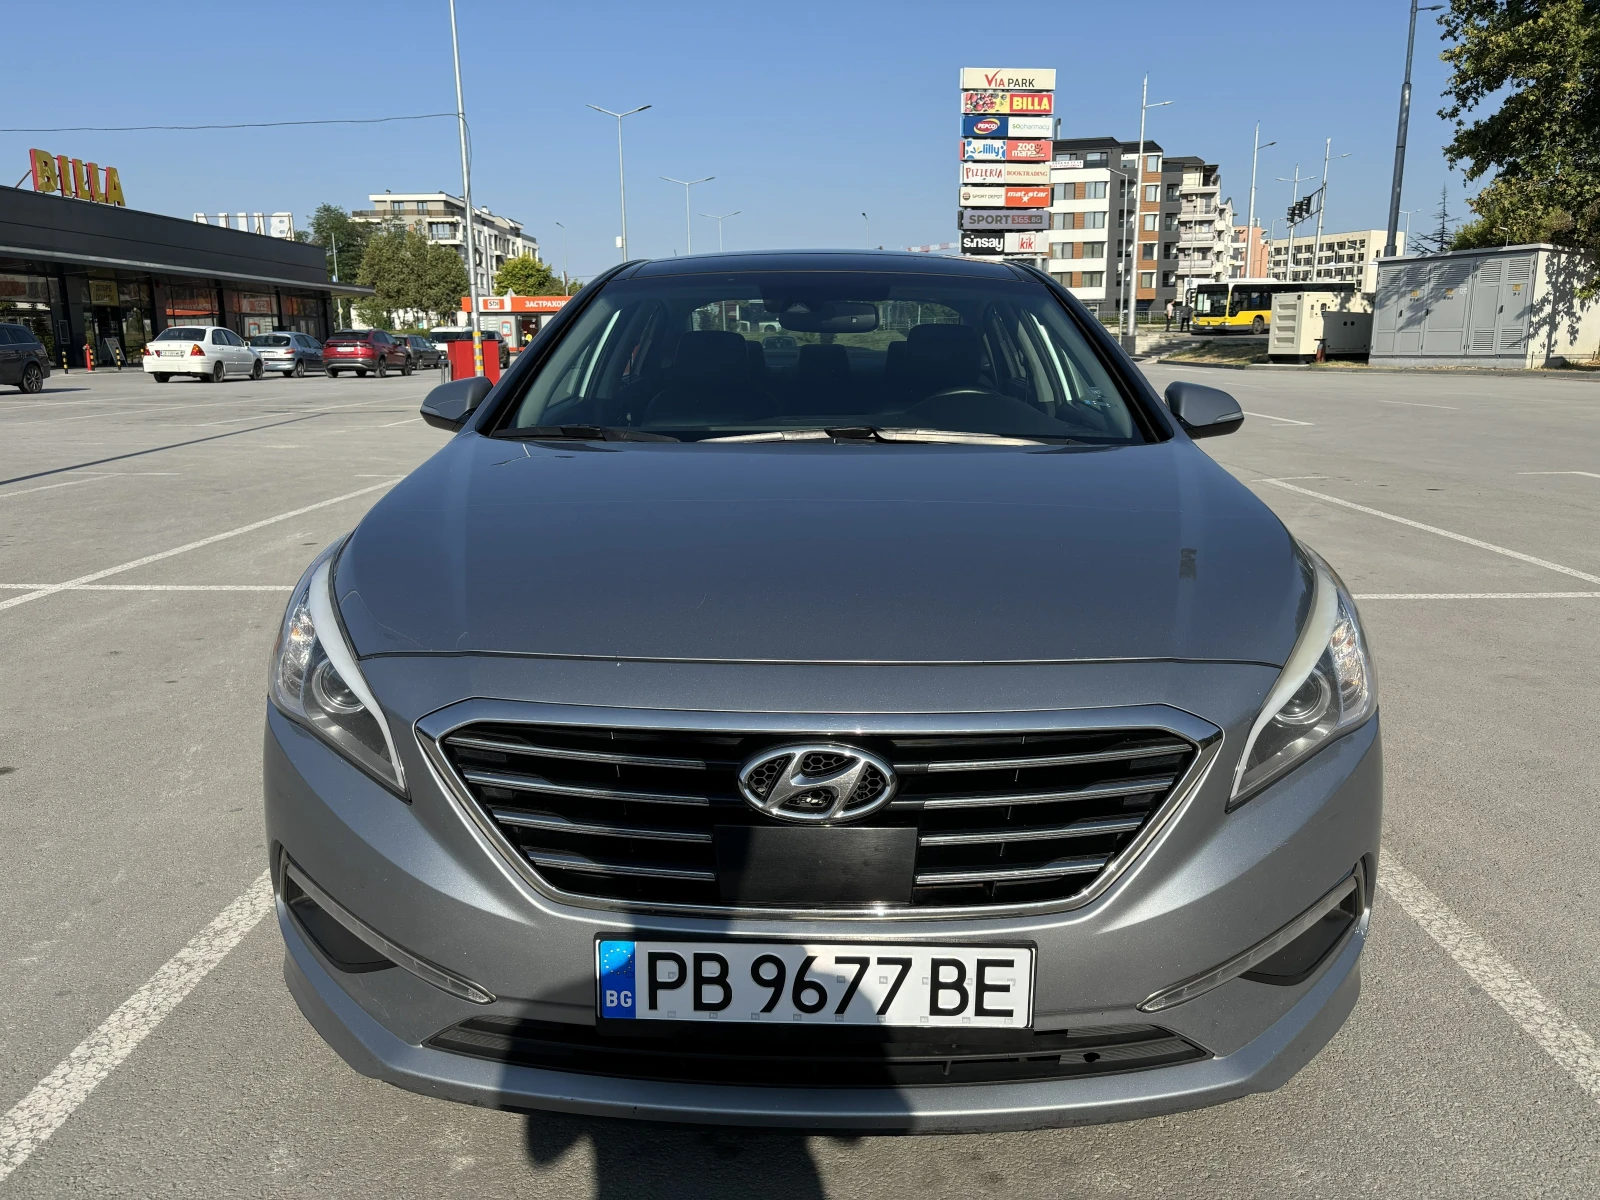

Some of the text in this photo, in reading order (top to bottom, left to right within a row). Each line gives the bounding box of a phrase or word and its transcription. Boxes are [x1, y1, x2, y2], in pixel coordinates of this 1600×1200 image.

[1007, 78, 1035, 87] PARK
[1012, 97, 1050, 110] BILLA
[977, 123, 998, 131] PEPCO
[982, 144, 1000, 157] lilly
[29, 148, 126, 207] BILLA
[965, 167, 1003, 179] PIZZERIA
[969, 215, 1010, 224] SPORT
[647, 951, 1015, 1018] PB 9677 BE
[605, 989, 633, 1008] BG
